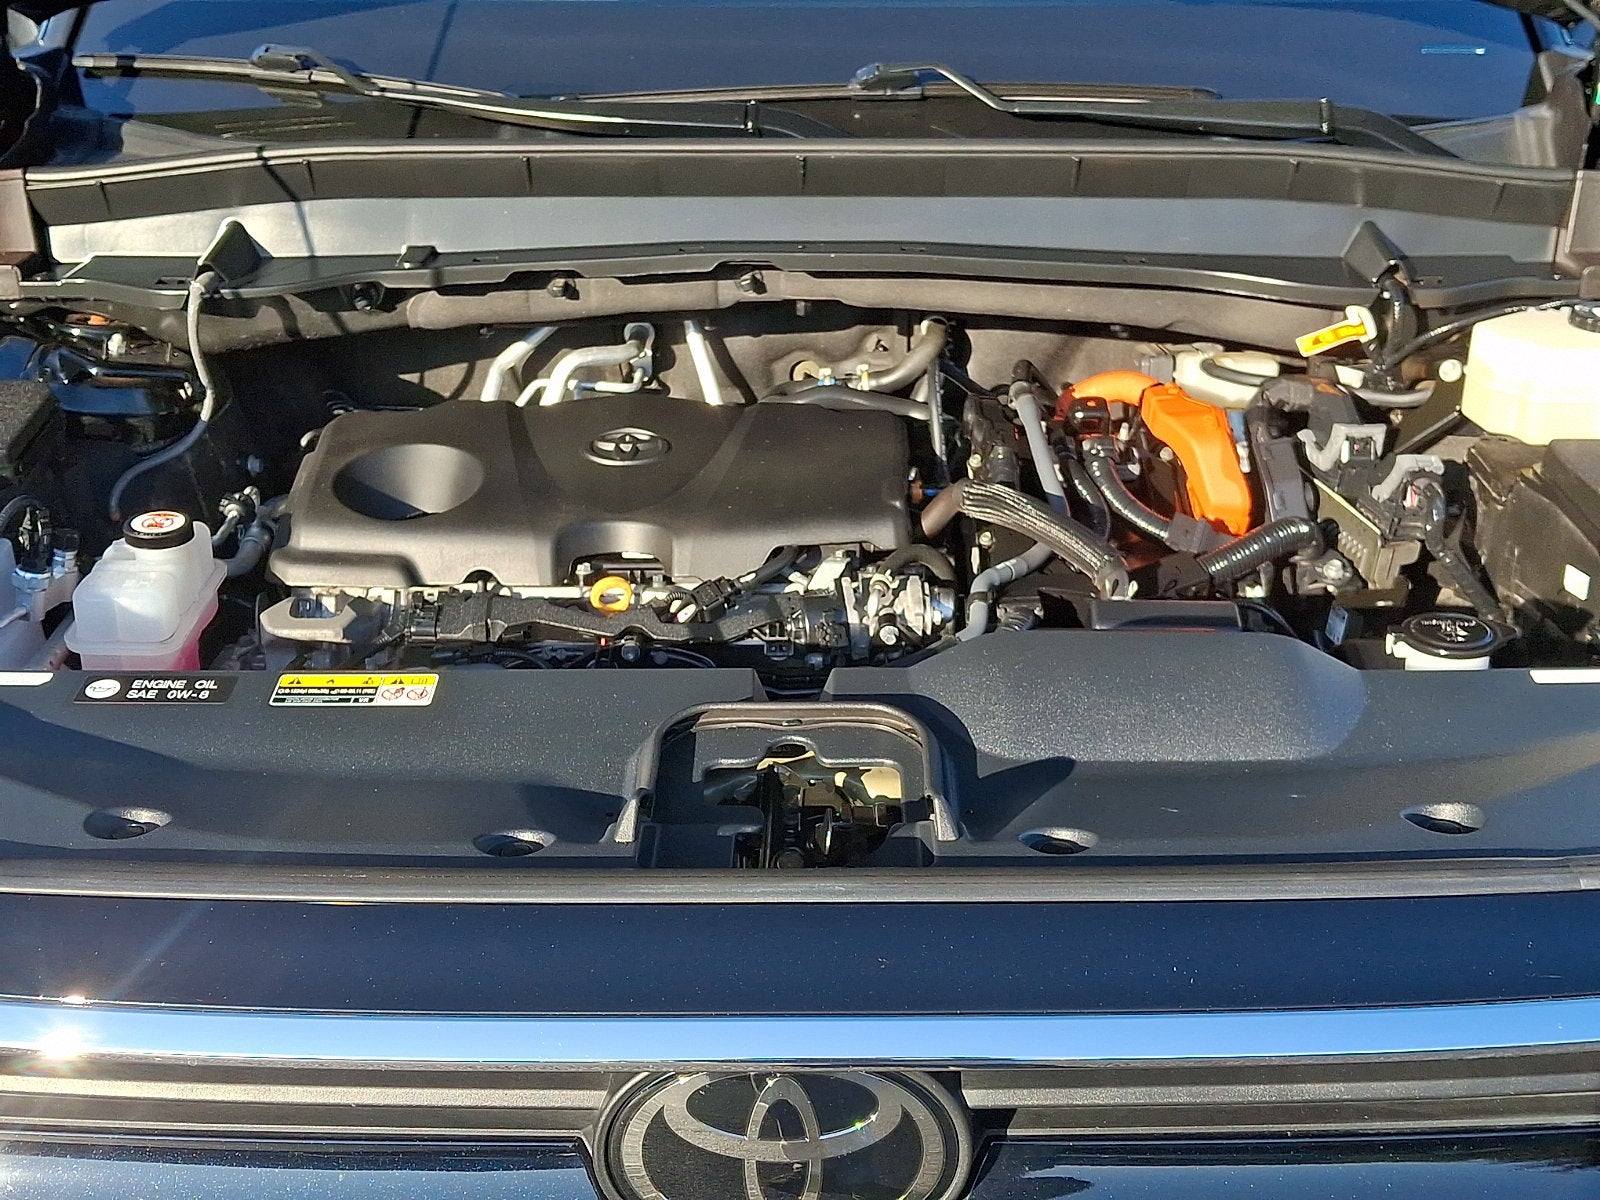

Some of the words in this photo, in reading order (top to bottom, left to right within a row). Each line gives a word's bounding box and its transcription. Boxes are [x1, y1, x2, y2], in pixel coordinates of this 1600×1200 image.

[131, 679, 188, 689] ENGINE
[194, 679, 218, 689] OIL
[125, 690, 159, 699] SAE
